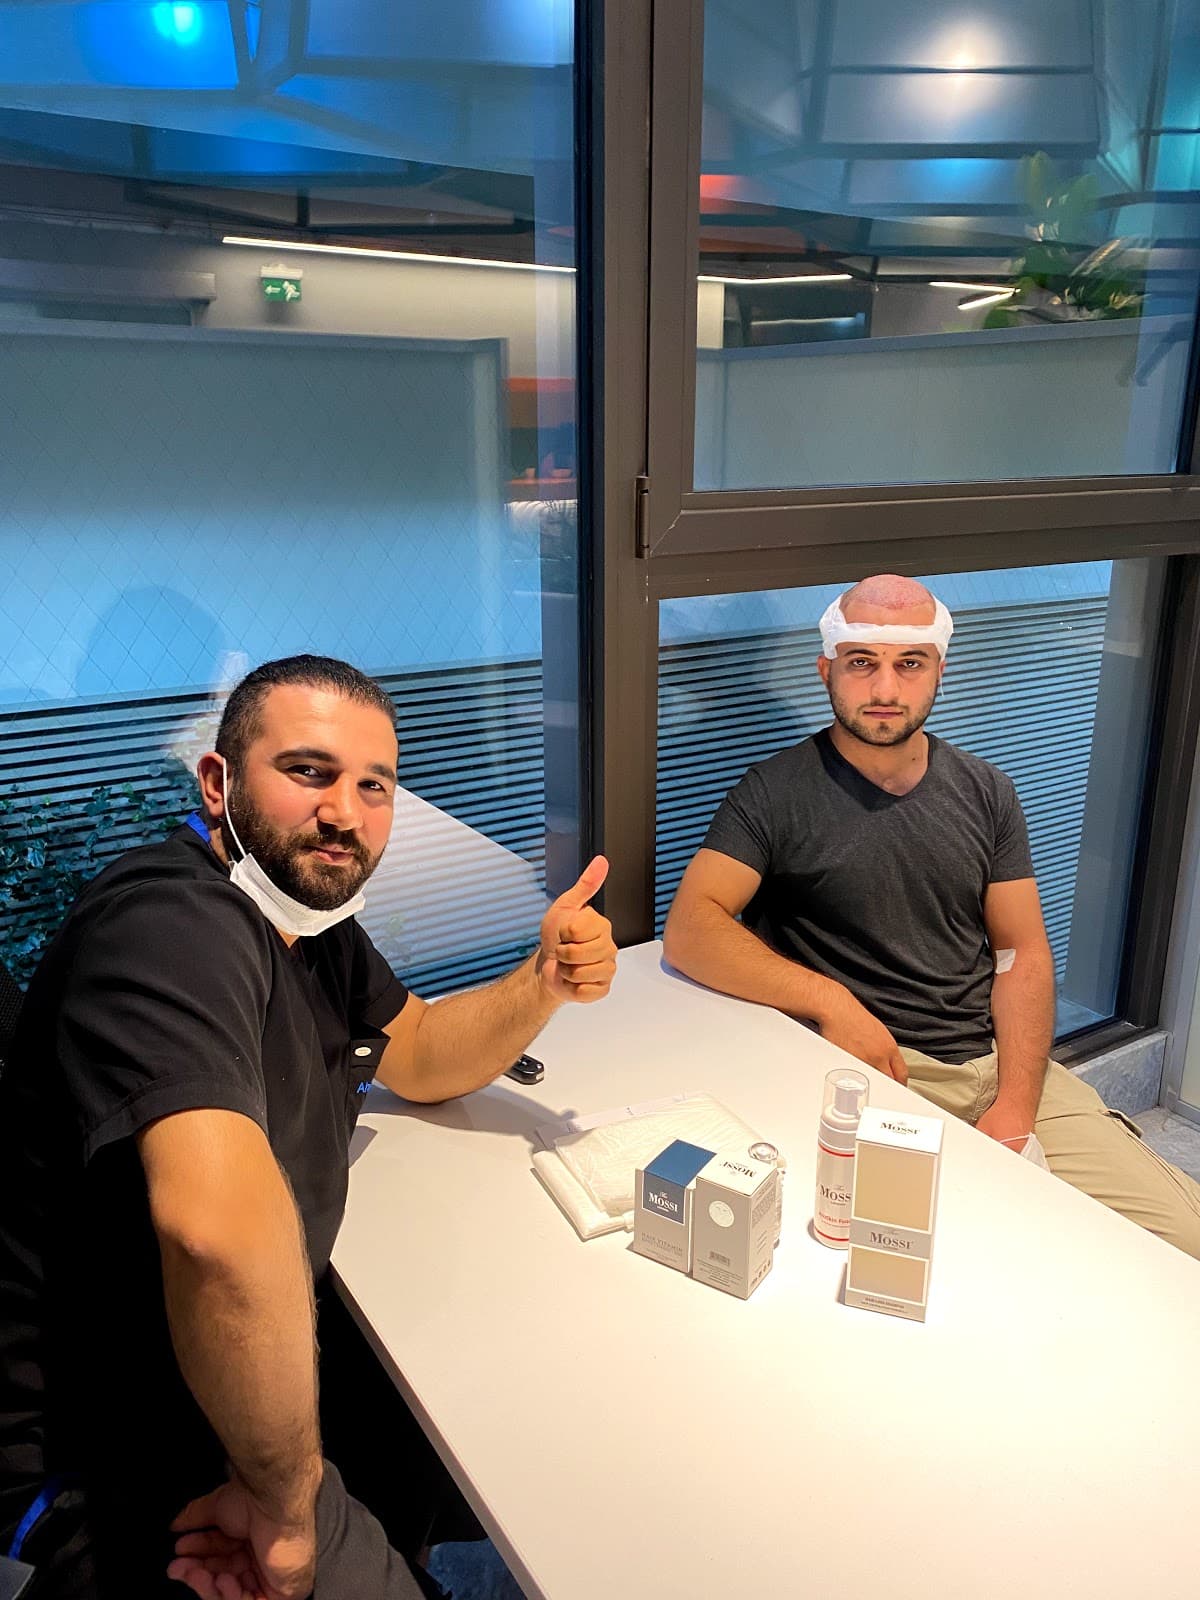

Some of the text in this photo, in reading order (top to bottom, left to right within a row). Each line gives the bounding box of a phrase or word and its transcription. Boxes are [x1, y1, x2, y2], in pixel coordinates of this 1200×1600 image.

[880, 1122, 920, 1135] MOSSI
[720, 1161, 757, 1178] MOSSI
[649, 1191, 678, 1212] MOSSI
[819, 1184, 852, 1202] MOSS
[870, 1231, 914, 1249] MOSSI
